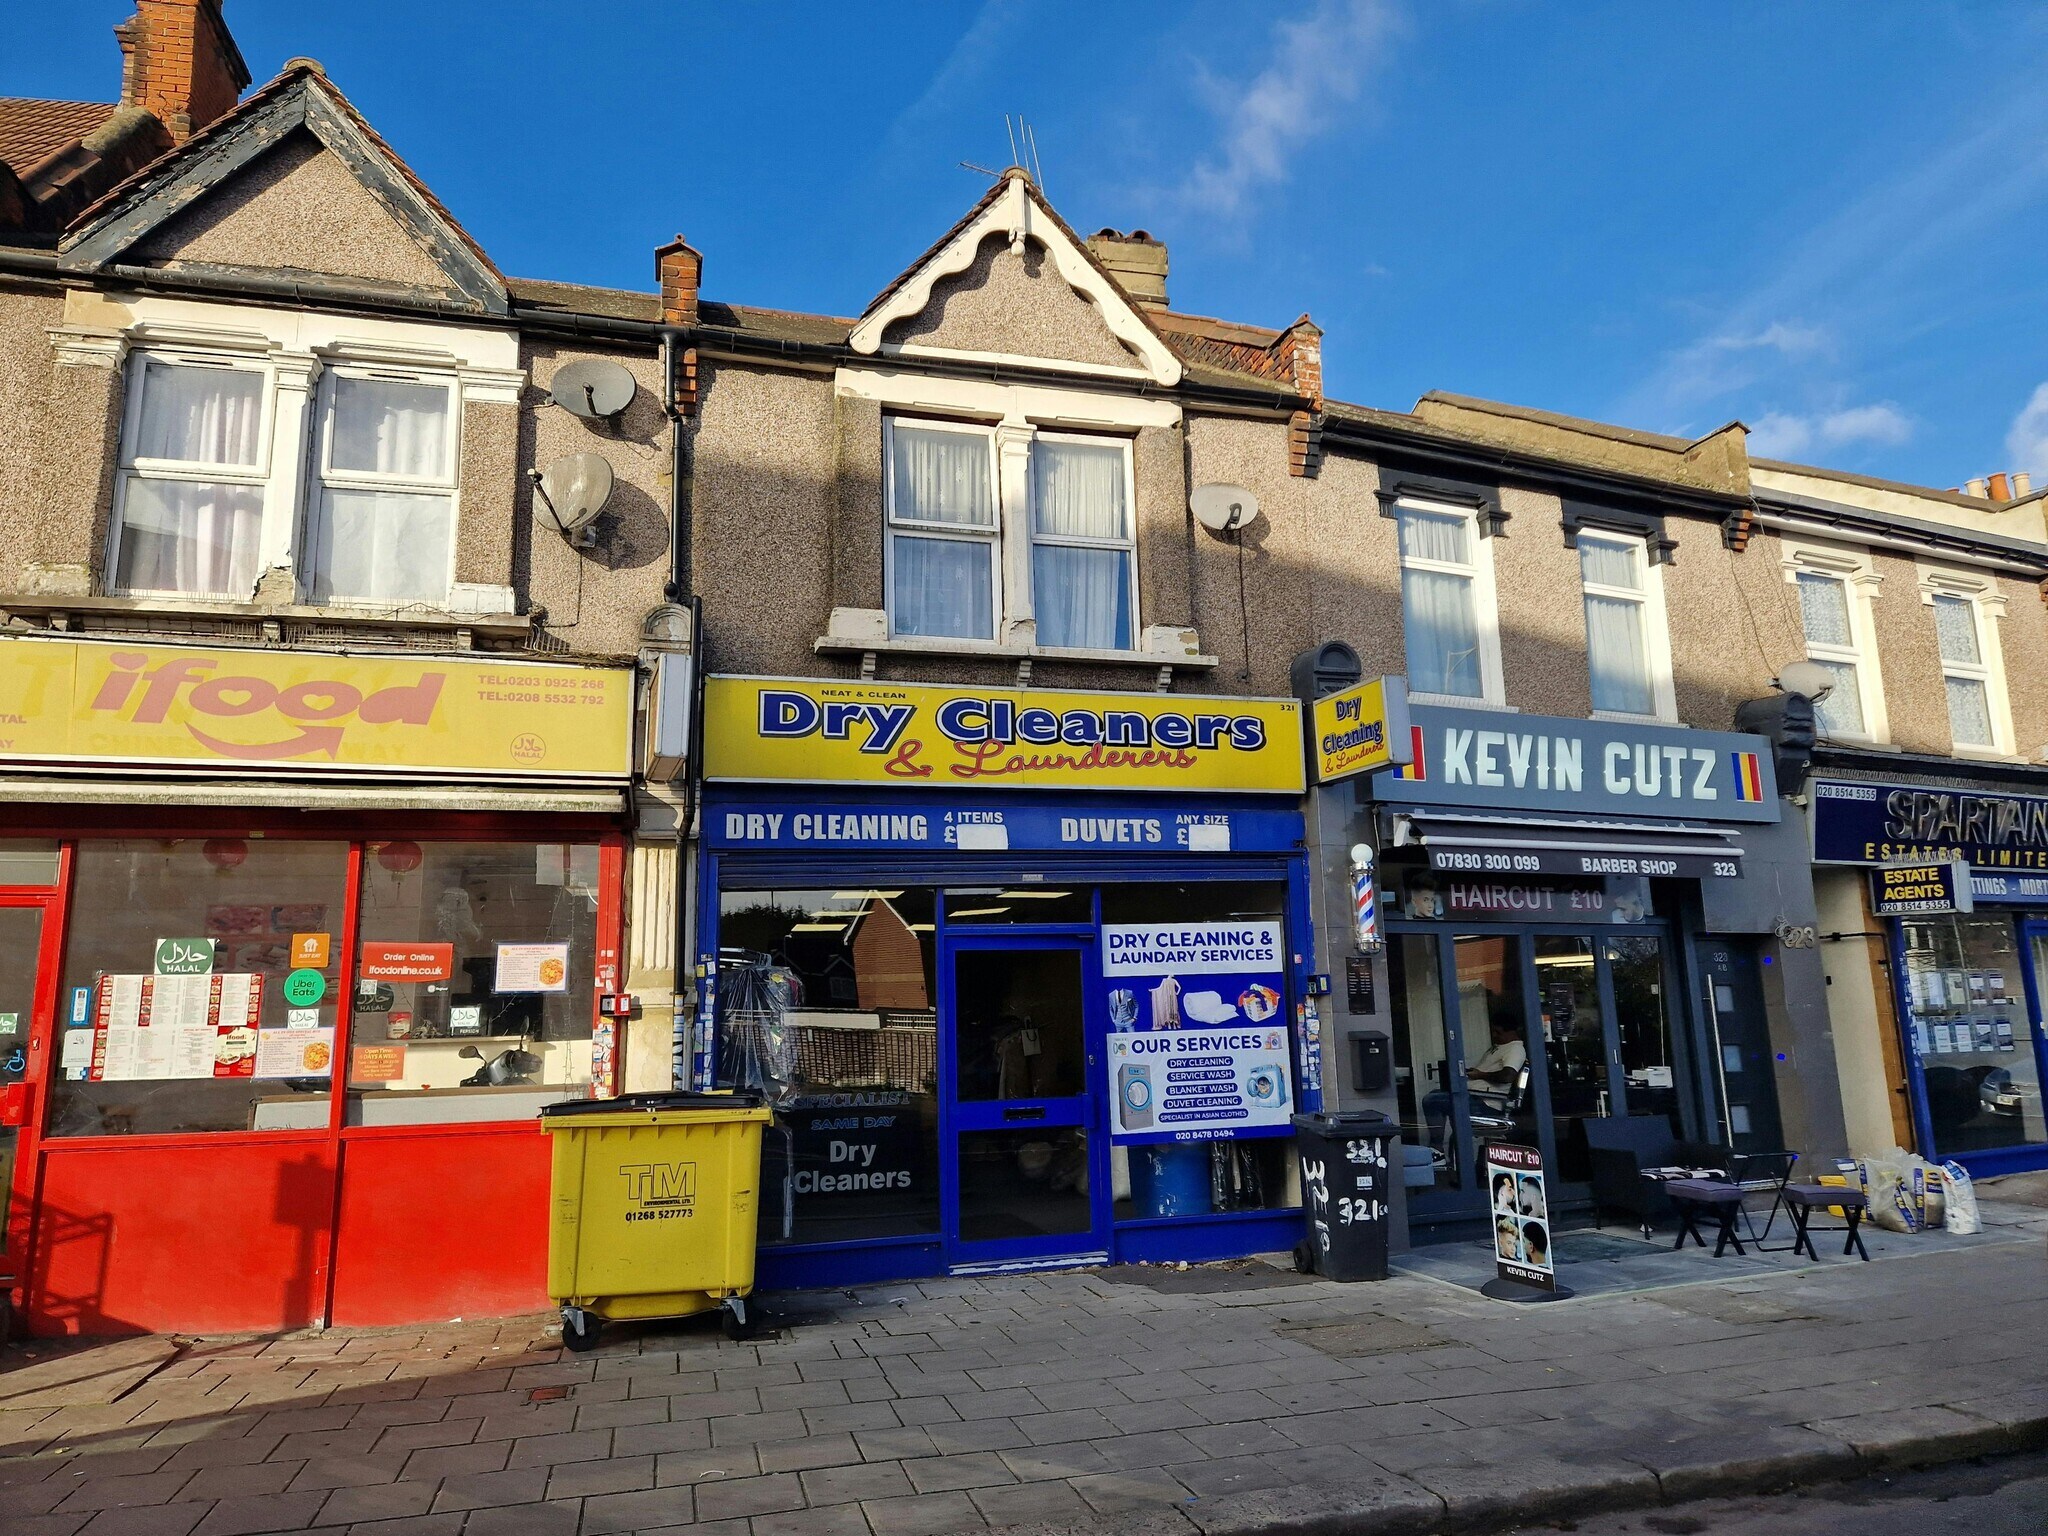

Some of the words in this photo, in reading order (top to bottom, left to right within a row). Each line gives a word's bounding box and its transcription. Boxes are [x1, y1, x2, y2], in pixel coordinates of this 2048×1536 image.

[91, 652, 446, 725] ifood
[478, 674, 540, 686] TEL:0203
[545, 677, 576, 688] 0925
[478, 690, 540, 702] TEL:0208
[545, 693, 576, 704] 5532
[581, 695, 604, 705] 792
[868, 691, 906, 699] CLEAN
[1280, 704, 1295, 712] 321
[1336, 696, 1361, 721] Dry
[758, 689, 917, 754] Dry
[935, 697, 1266, 751] Cleaners
[1323, 719, 1383, 755] Cleaning
[884, 739, 934, 777] &
[950, 738, 1197, 778] Launderers
[1325, 758, 1333, 773] &
[1336, 743, 1384, 769] Launderers
[1444, 727, 1584, 792] KEVIN
[1603, 741, 1718, 800] CUTZ
[1817, 786, 1832, 796] 020
[1835, 787, 1853, 798] 8514
[1856, 788, 1876, 799] 5355
[944, 811, 953, 823] 4
[958, 812, 1003, 823] ITEMS
[1175, 814, 1199, 824] ANY
[1203, 815, 1229, 825] SIZE
[1884, 789, 2048, 847] SPARTAN
[726, 813, 783, 839] DRY
[793, 814, 927, 840] CLEANING
[944, 825, 957, 844] £
[1061, 818, 1162, 842] DUVETS
[1176, 828, 1189, 845] £
[1436, 852, 1482, 869] 07830
[1484, 854, 1511, 870] 300
[1513, 855, 1541, 871] 099
[1865, 843, 1962, 861] ESTATES
[1977, 849, 2047, 867] LIMITE
[1581, 856, 1638, 874] BARBER
[1641, 860, 1677, 875] SHOP
[1713, 862, 1737, 877] 323
[1884, 867, 1939, 884] ESTATE
[1450, 883, 1554, 911] HAIRCUT
[1570, 890, 1603, 910] £10
[1884, 884, 1945, 900] AGENTS
[1881, 903, 1898, 912] 020
[1901, 902, 1922, 911] 8514
[1926, 900, 1949, 909] 5355
[1109, 933, 1150, 948] DRY
[1155, 931, 1254, 947] CLEANING
[1260, 930, 1272, 945] &
[162, 942, 208, 964] حلال
[383, 953, 406, 961] Order
[1111, 950, 1196, 964] LAUNDARY
[1201, 949, 1274, 962] SERVICES
[293, 980, 316, 988] Uber
[1131, 1038, 1171, 1053] OUR
[1177, 1034, 1262, 1052] SERVICES
[1170, 1059, 1187, 1067] DRY
[1189, 1057, 1231, 1066] CLEANING
[1170, 1072, 1205, 1080] SERVICE
[1206, 1071, 1232, 1079] WASH
[1169, 1085, 1207, 1094] BLANKET
[1209, 1084, 1234, 1093] WASH
[793, 1091, 910, 1109] SPECIALIST
[1167, 1099, 1195, 1107] DUVET
[1196, 1097, 1239, 1106] CLEANING
[811, 1118, 859, 1130] SAME
[863, 1116, 896, 1128] DAY
[1160, 1113, 1193, 1121] SPECIALIST
[1220, 1110, 1247, 1118] CLOTHES
[1175, 1132, 1190, 1140] 020
[1192, 1131, 1212, 1139] 8478
[1213, 1129, 1235, 1138] 0494
[830, 1141, 877, 1166] Dry
[1489, 1148, 1522, 1163] HAIRCUT
[1527, 1153, 1540, 1165] £10
[793, 1170, 911, 1193] Cleaners
[626, 1211, 655, 1221] 01268
[658, 1209, 693, 1219] 527773
[1507, 1266, 1527, 1277] KEVIN
[1528, 1271, 1544, 1281] CUTZ
